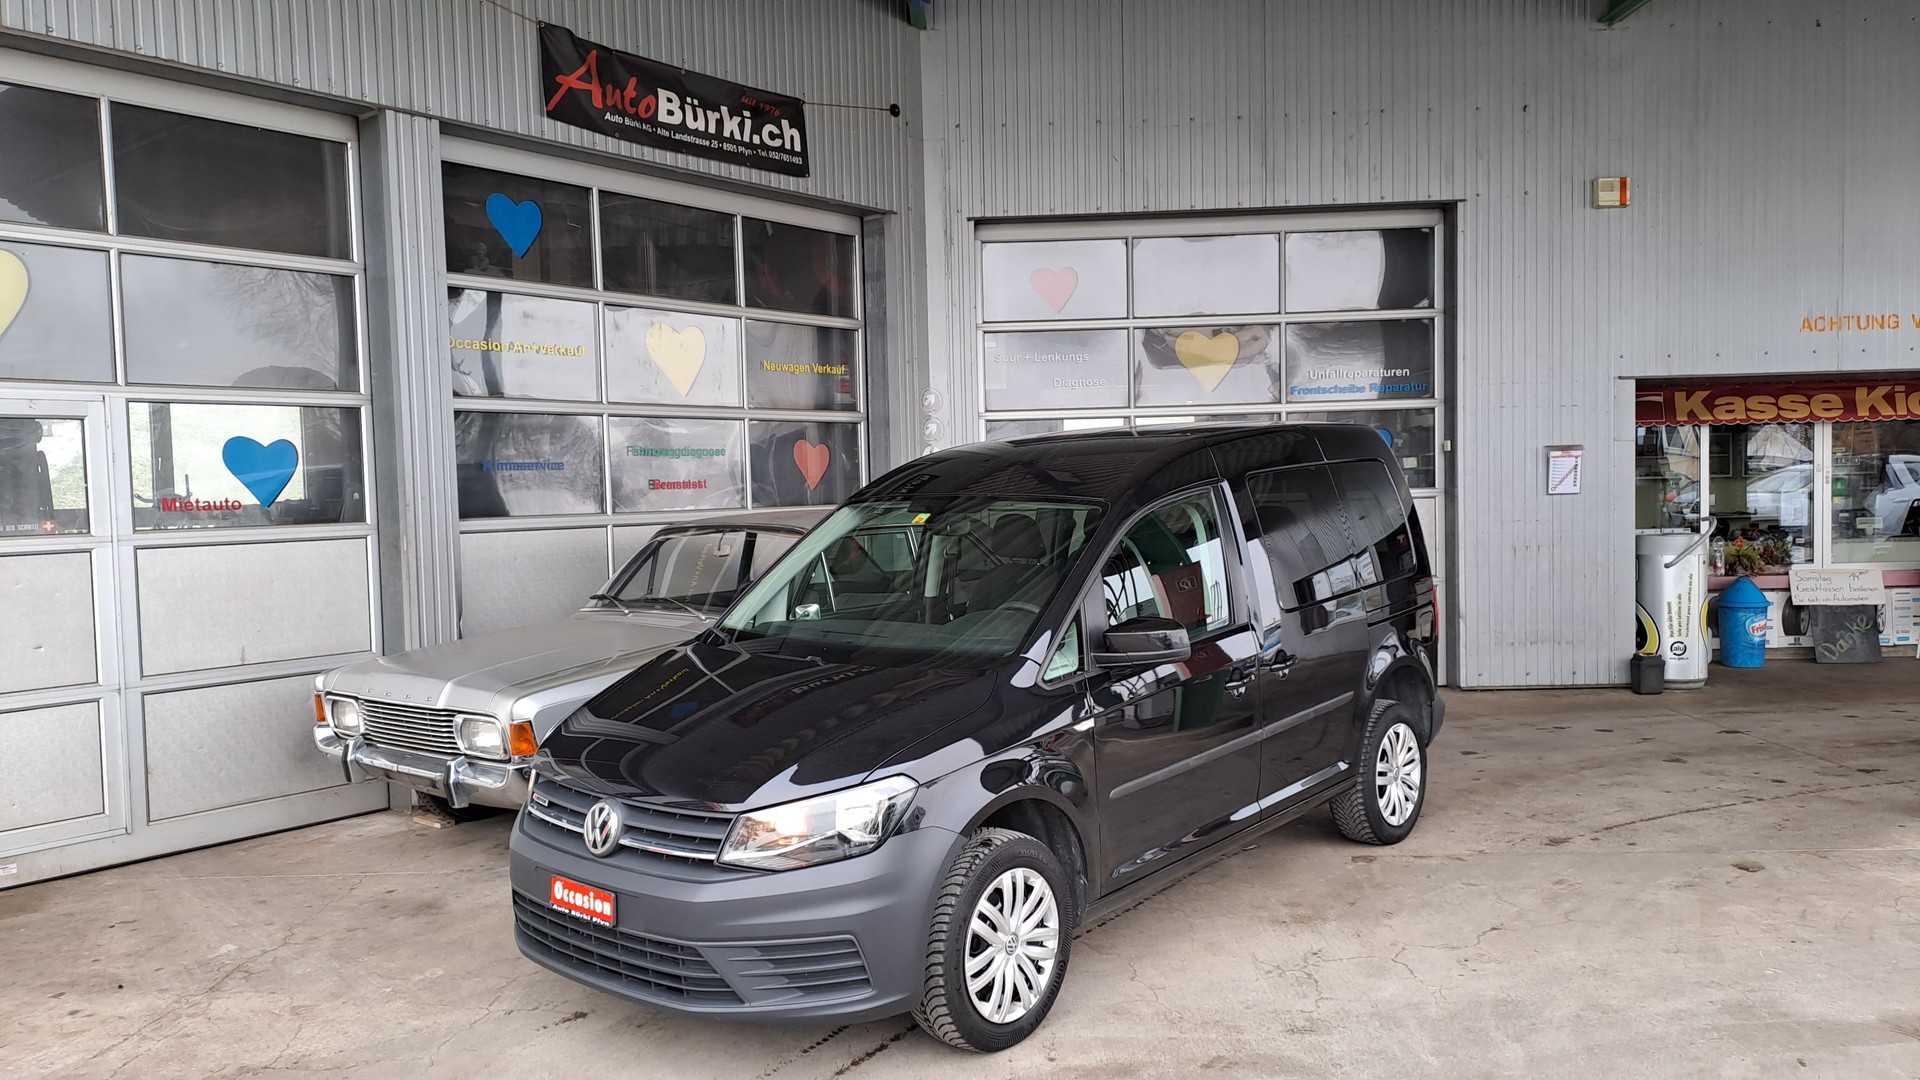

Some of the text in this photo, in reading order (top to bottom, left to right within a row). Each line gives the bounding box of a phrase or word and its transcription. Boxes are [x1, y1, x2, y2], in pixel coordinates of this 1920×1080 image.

[759, 103, 781, 117] 1976
[604, 111, 623, 124] Auto
[624, 117, 641, 129] Bürki
[642, 122, 652, 132] AG
[656, 127, 670, 137] Alte
[671, 130, 711, 147] Landstrasse
[711, 139, 719, 148] 25
[722, 142, 738, 153] 8505
[1800, 312, 1900, 333] ACHTUNG
[993, 353, 1021, 365] Spur
[1033, 352, 1089, 364] Lenkungs
[763, 360, 846, 375] Neuwagen Verkauf
[1308, 367, 1410, 380] Unfallreparaturen
[1052, 377, 1106, 389] Diagnose
[1290, 381, 1428, 395] Frontscheibe Reparatur
[1674, 390, 1844, 421] Kasse
[161, 497, 242, 512] Mietauto
[1795, 572, 1832, 584] Samstag
[1796, 583, 1845, 593] Geschlossen
[553, 880, 611, 917] Occasion
[552, 904, 569, 914] Auto
